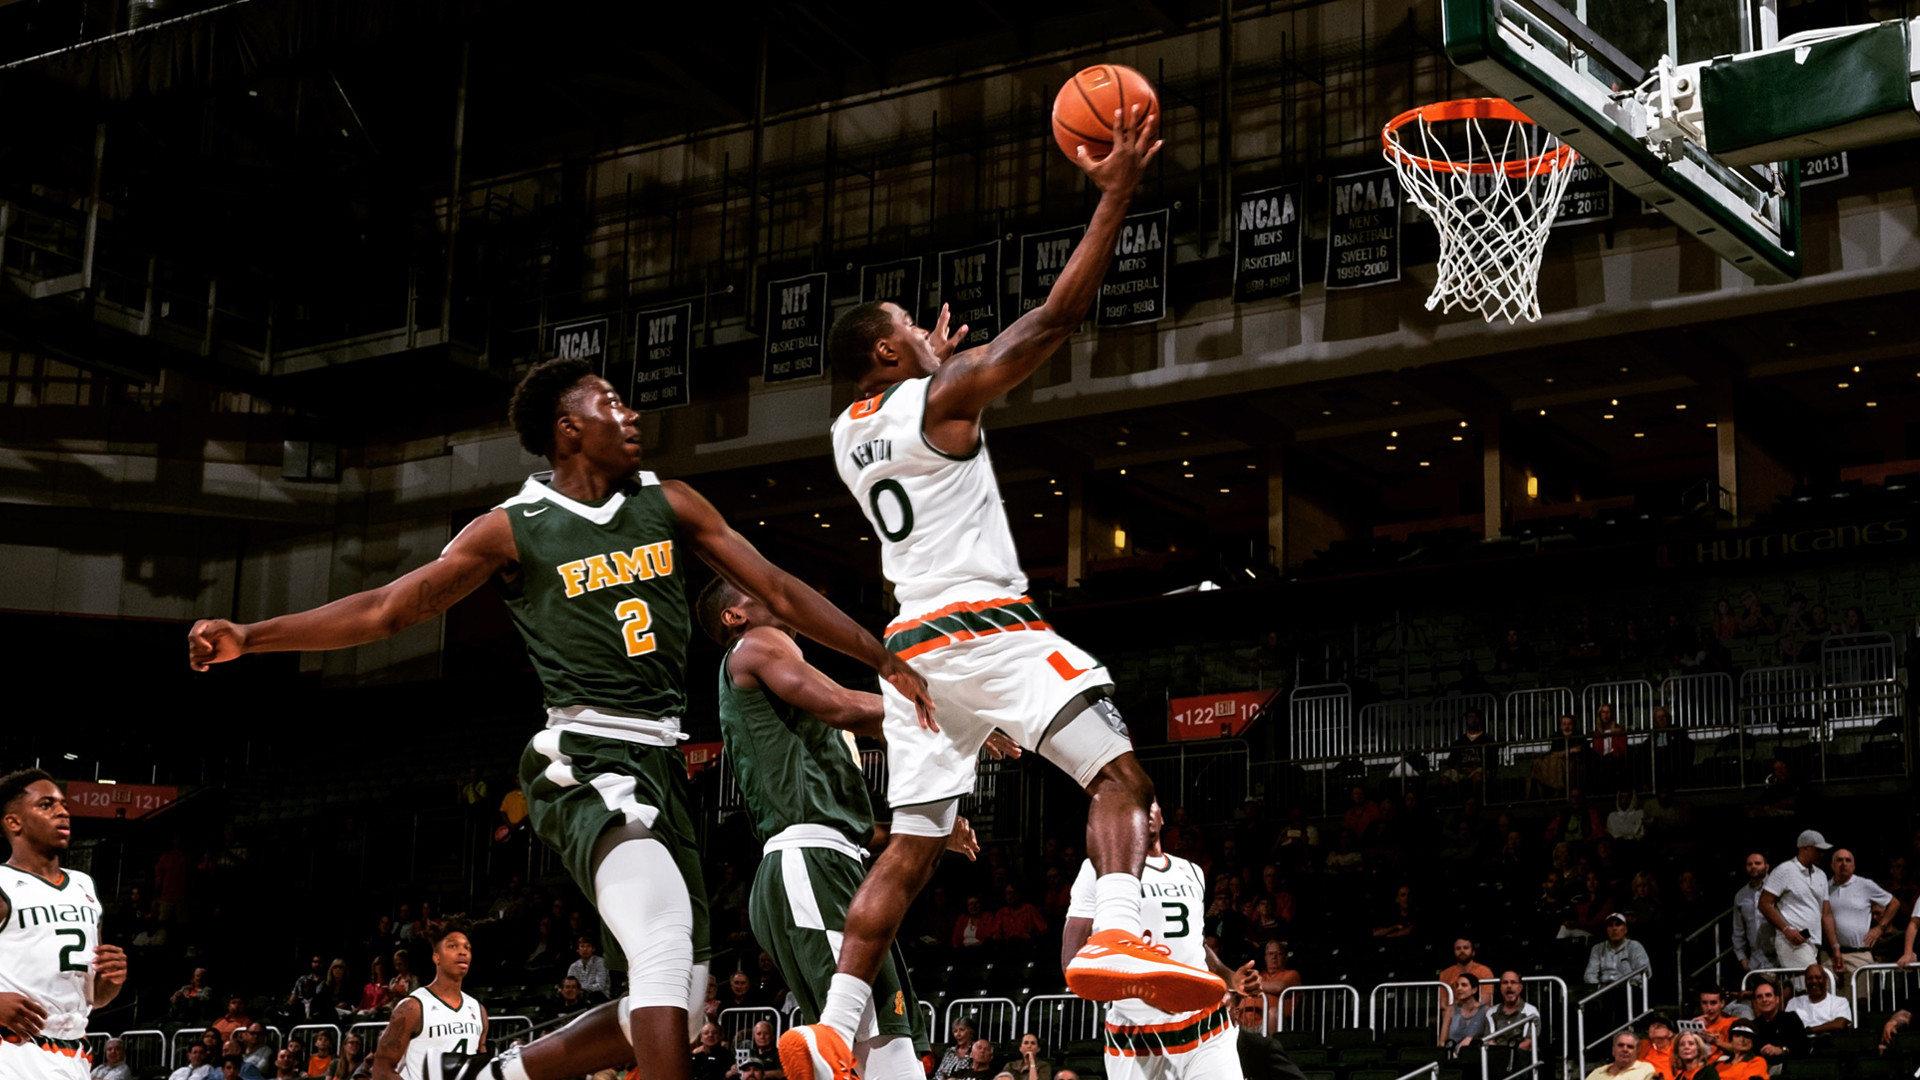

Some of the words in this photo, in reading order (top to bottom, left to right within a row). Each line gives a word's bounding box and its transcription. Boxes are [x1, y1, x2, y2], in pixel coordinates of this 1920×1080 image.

[1806, 155, 1840, 176] 2013
[1335, 177, 1395, 216] NCAA
[1574, 190, 1608, 201] Season
[1239, 192, 1296, 231] NCAA
[1577, 198, 1605, 215] 2013
[1348, 213, 1380, 230] MEN'S
[1253, 229, 1283, 248] MEN'S
[1333, 227, 1395, 248] BASKETBALL
[1036, 238, 1071, 271] NIT
[1118, 257, 1147, 272] MEN'S
[1340, 246, 1373, 265] SWEET
[1375, 244, 1389, 259] 16
[954, 253, 986, 287] NIT
[1038, 273, 1058, 287] MEN
[1336, 260, 1390, 280] 1999-2000
[874, 269, 905, 300] NIT
[1102, 276, 1160, 296] BASKETBALL
[780, 283, 811, 316] NIT
[648, 315, 677, 346] NIT
[782, 315, 806, 331] MEN'S
[559, 328, 600, 359] NCAA
[649, 345, 672, 360] MEN'S
[770, 335, 819, 354] BASKETBALL
[637, 363, 684, 383] BASKETBALL
[850, 439, 892, 471] NEWTON
[870, 478, 914, 543] 0
[556, 539, 673, 600] FAMU
[614, 597, 657, 658] 2
[1185, 707, 1214, 726] 122
[82, 792, 110, 807] 120
[135, 794, 161, 809] 121
[1161, 902, 1190, 938] 3
[55, 928, 88, 972] 2
